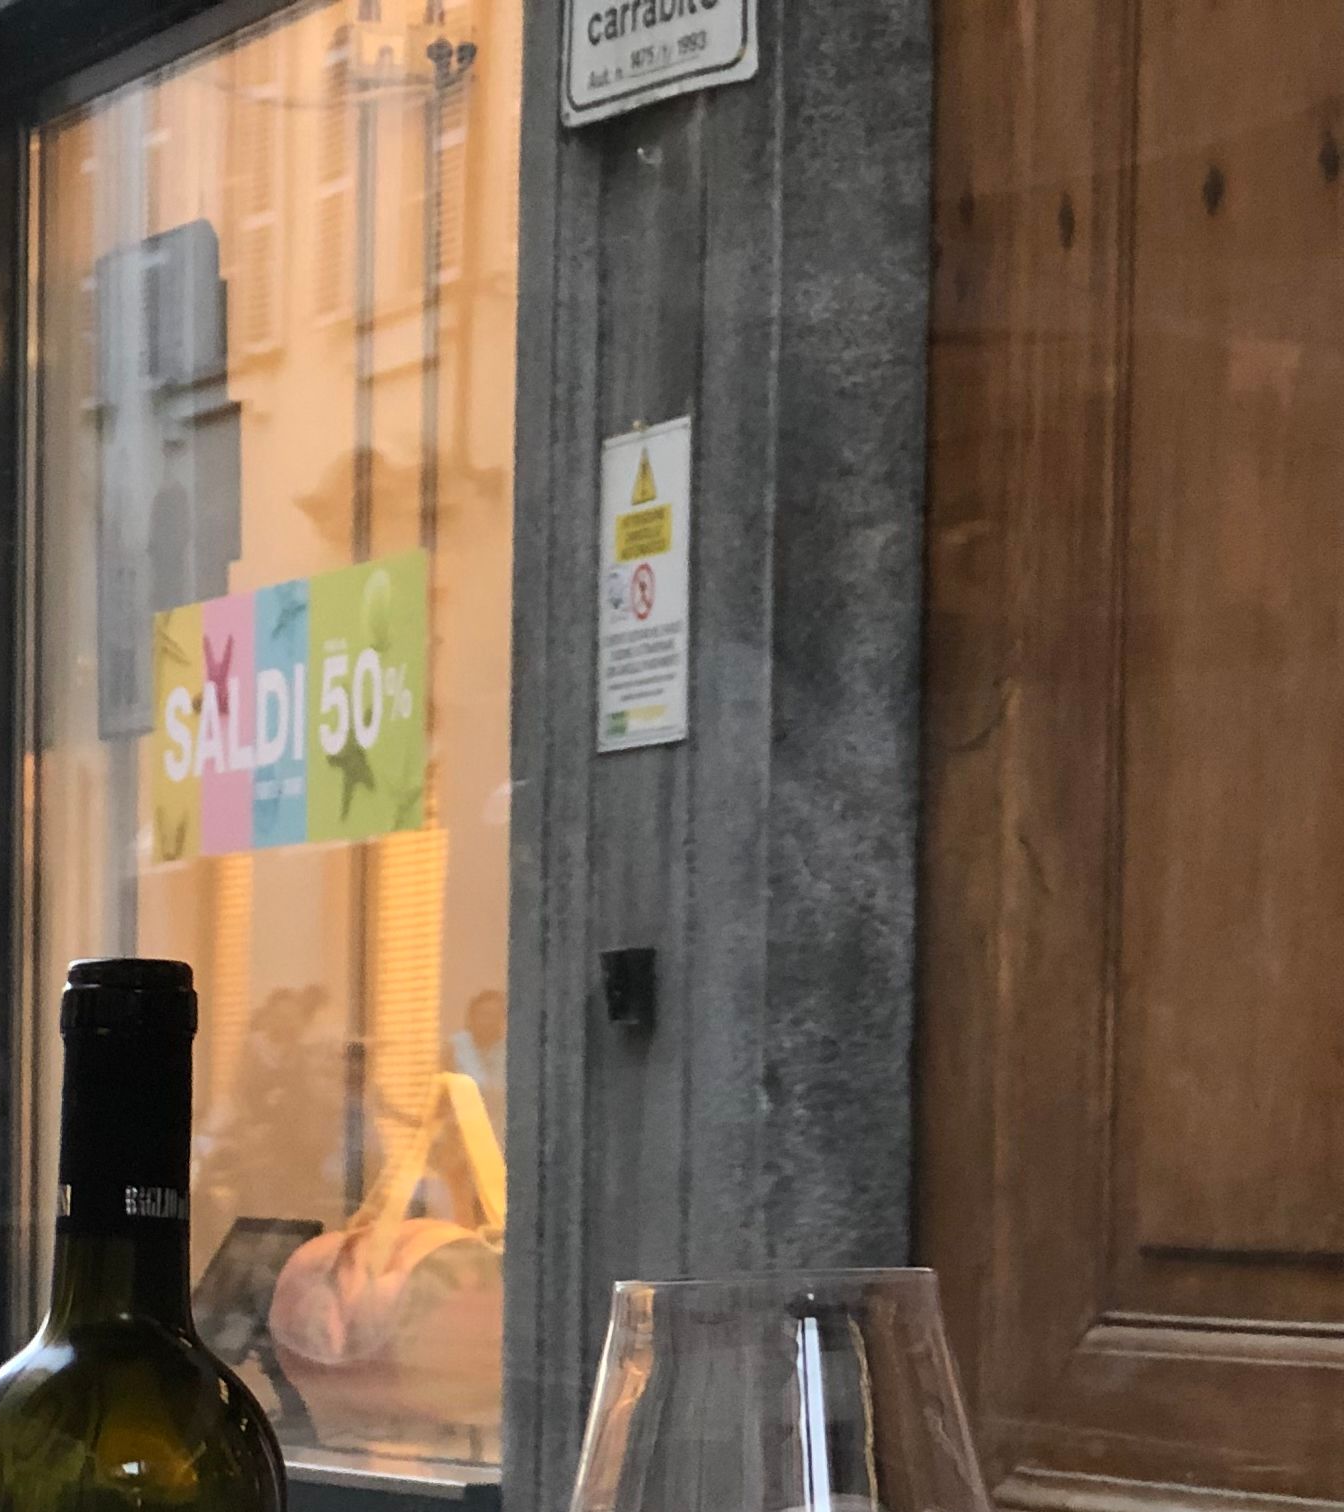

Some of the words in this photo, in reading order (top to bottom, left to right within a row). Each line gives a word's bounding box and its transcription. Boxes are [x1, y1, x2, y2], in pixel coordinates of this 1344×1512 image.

[587, 0, 719, 45] carrabi
[164, 663, 305, 783] SALDI
[319, 648, 413, 756] 50%
